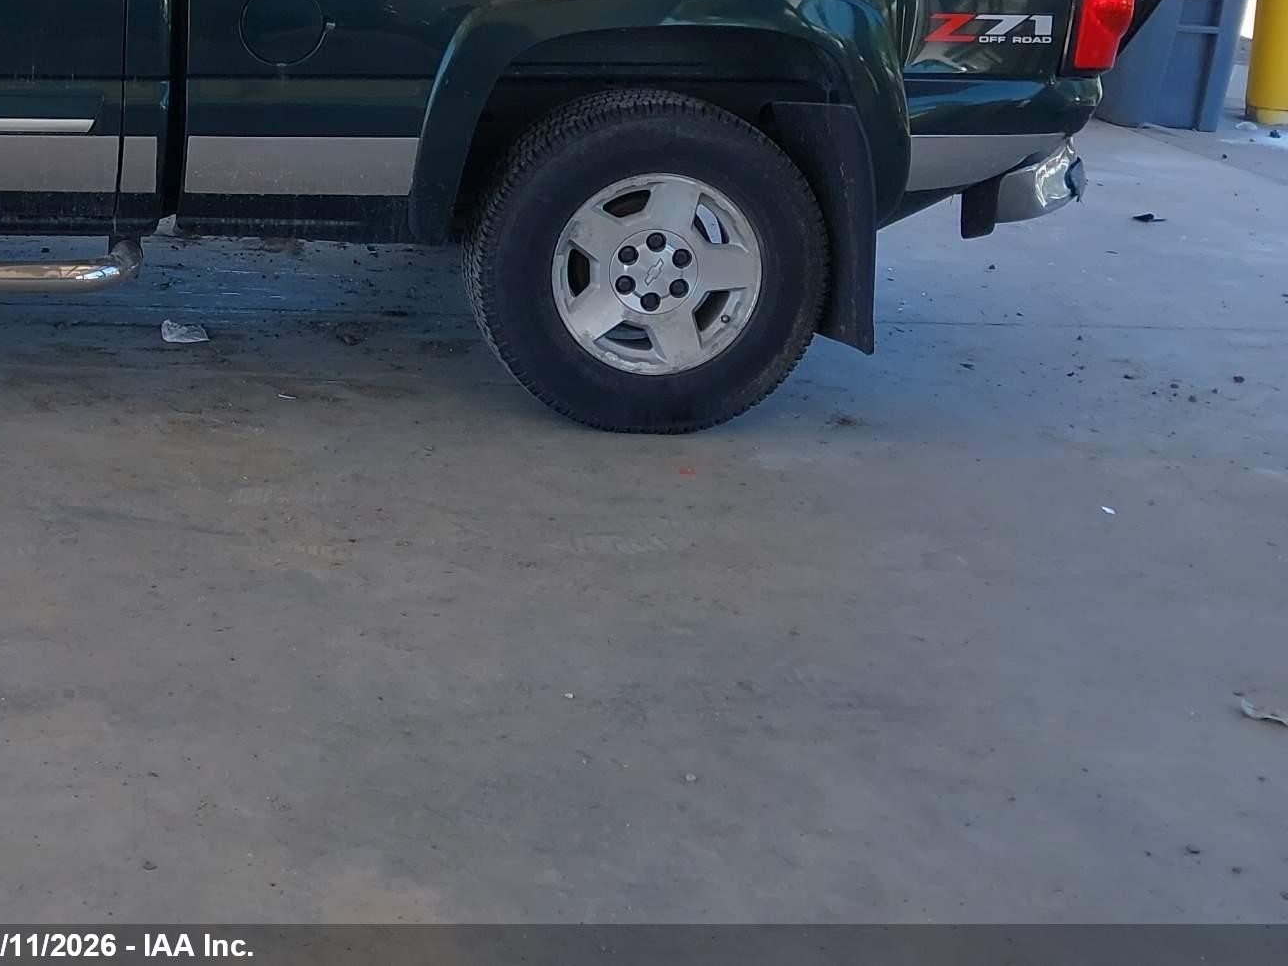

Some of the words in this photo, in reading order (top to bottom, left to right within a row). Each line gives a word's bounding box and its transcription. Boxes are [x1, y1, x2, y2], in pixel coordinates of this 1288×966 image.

[923, 12, 1054, 44] Z71
[978, 36, 1006, 44] OFF
[1012, 36, 1053, 44] ROAD
